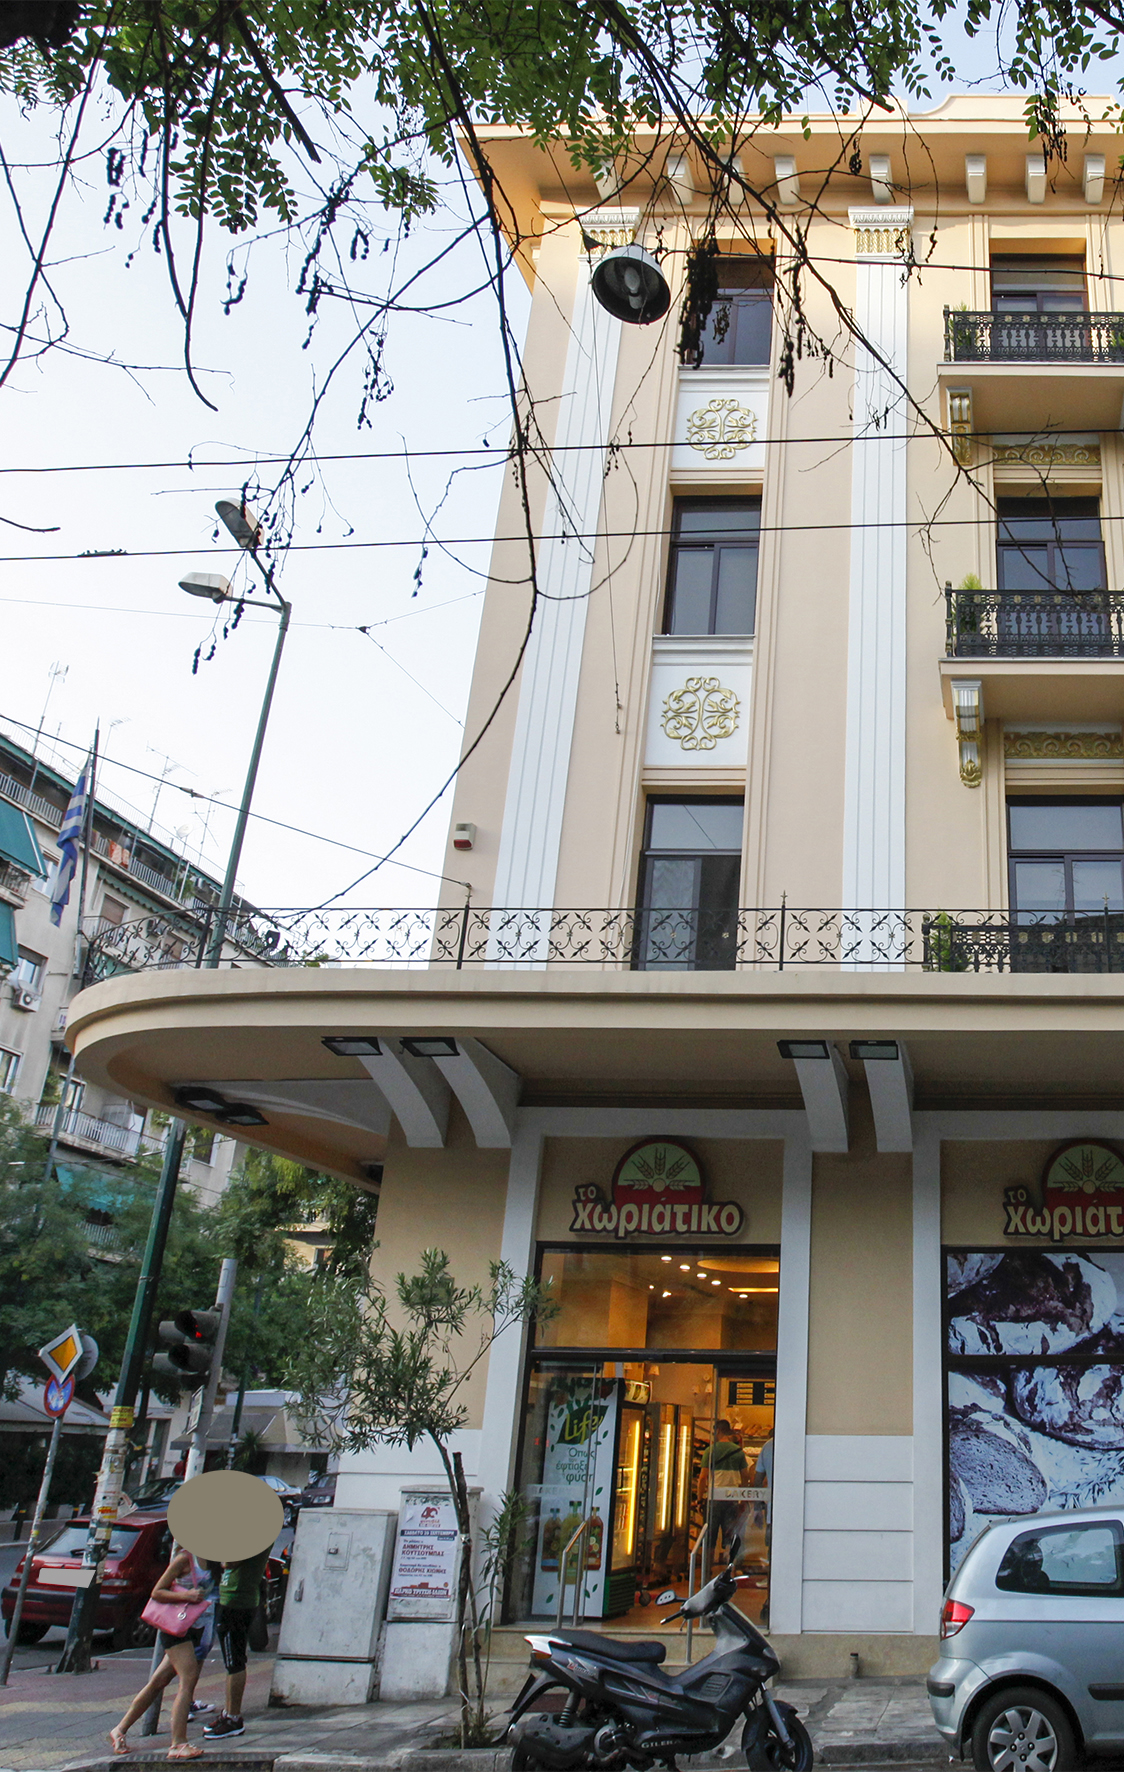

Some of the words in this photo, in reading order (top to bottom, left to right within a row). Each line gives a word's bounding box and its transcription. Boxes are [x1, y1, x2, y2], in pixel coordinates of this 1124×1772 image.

[577, 1185, 597, 1200] το
[1007, 1188, 1027, 1203] το
[572, 1197, 741, 1238] χωριάτικο
